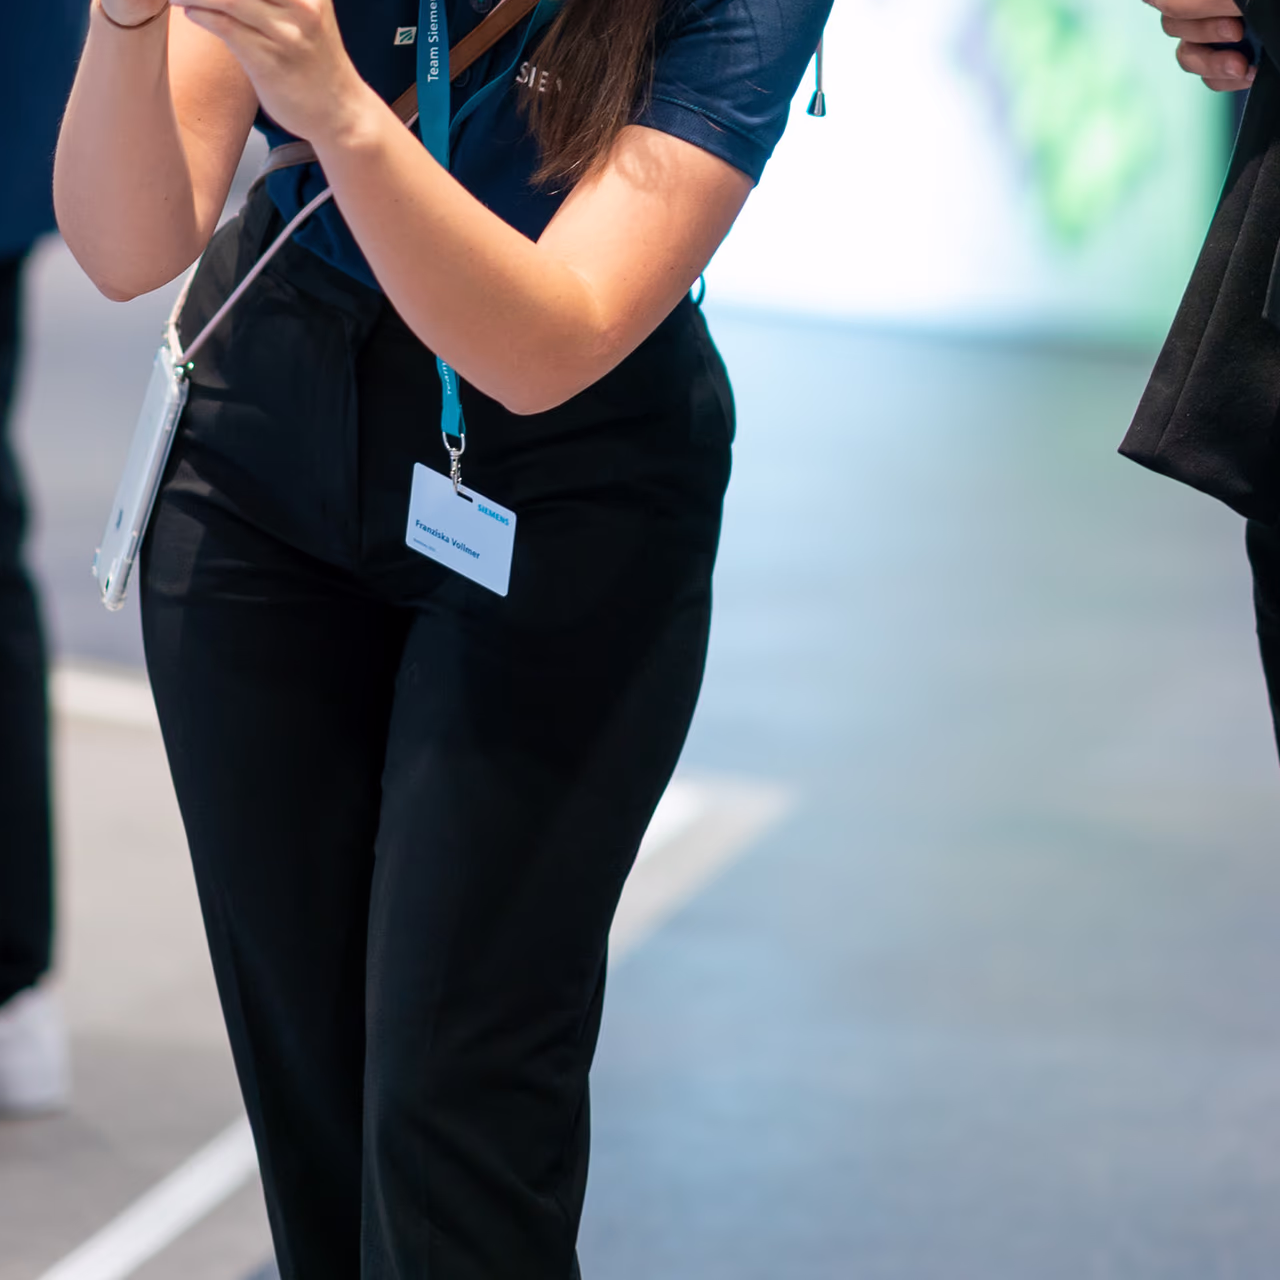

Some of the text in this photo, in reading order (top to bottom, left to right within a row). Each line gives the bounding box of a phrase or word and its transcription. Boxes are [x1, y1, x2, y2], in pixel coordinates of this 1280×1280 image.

[427, 46, 439, 83] Team
[515, 61, 562, 92] SIE
[477, 503, 510, 526] SIEMENS
[415, 519, 450, 544] Franziska
[451, 537, 481, 559] Vollmer
